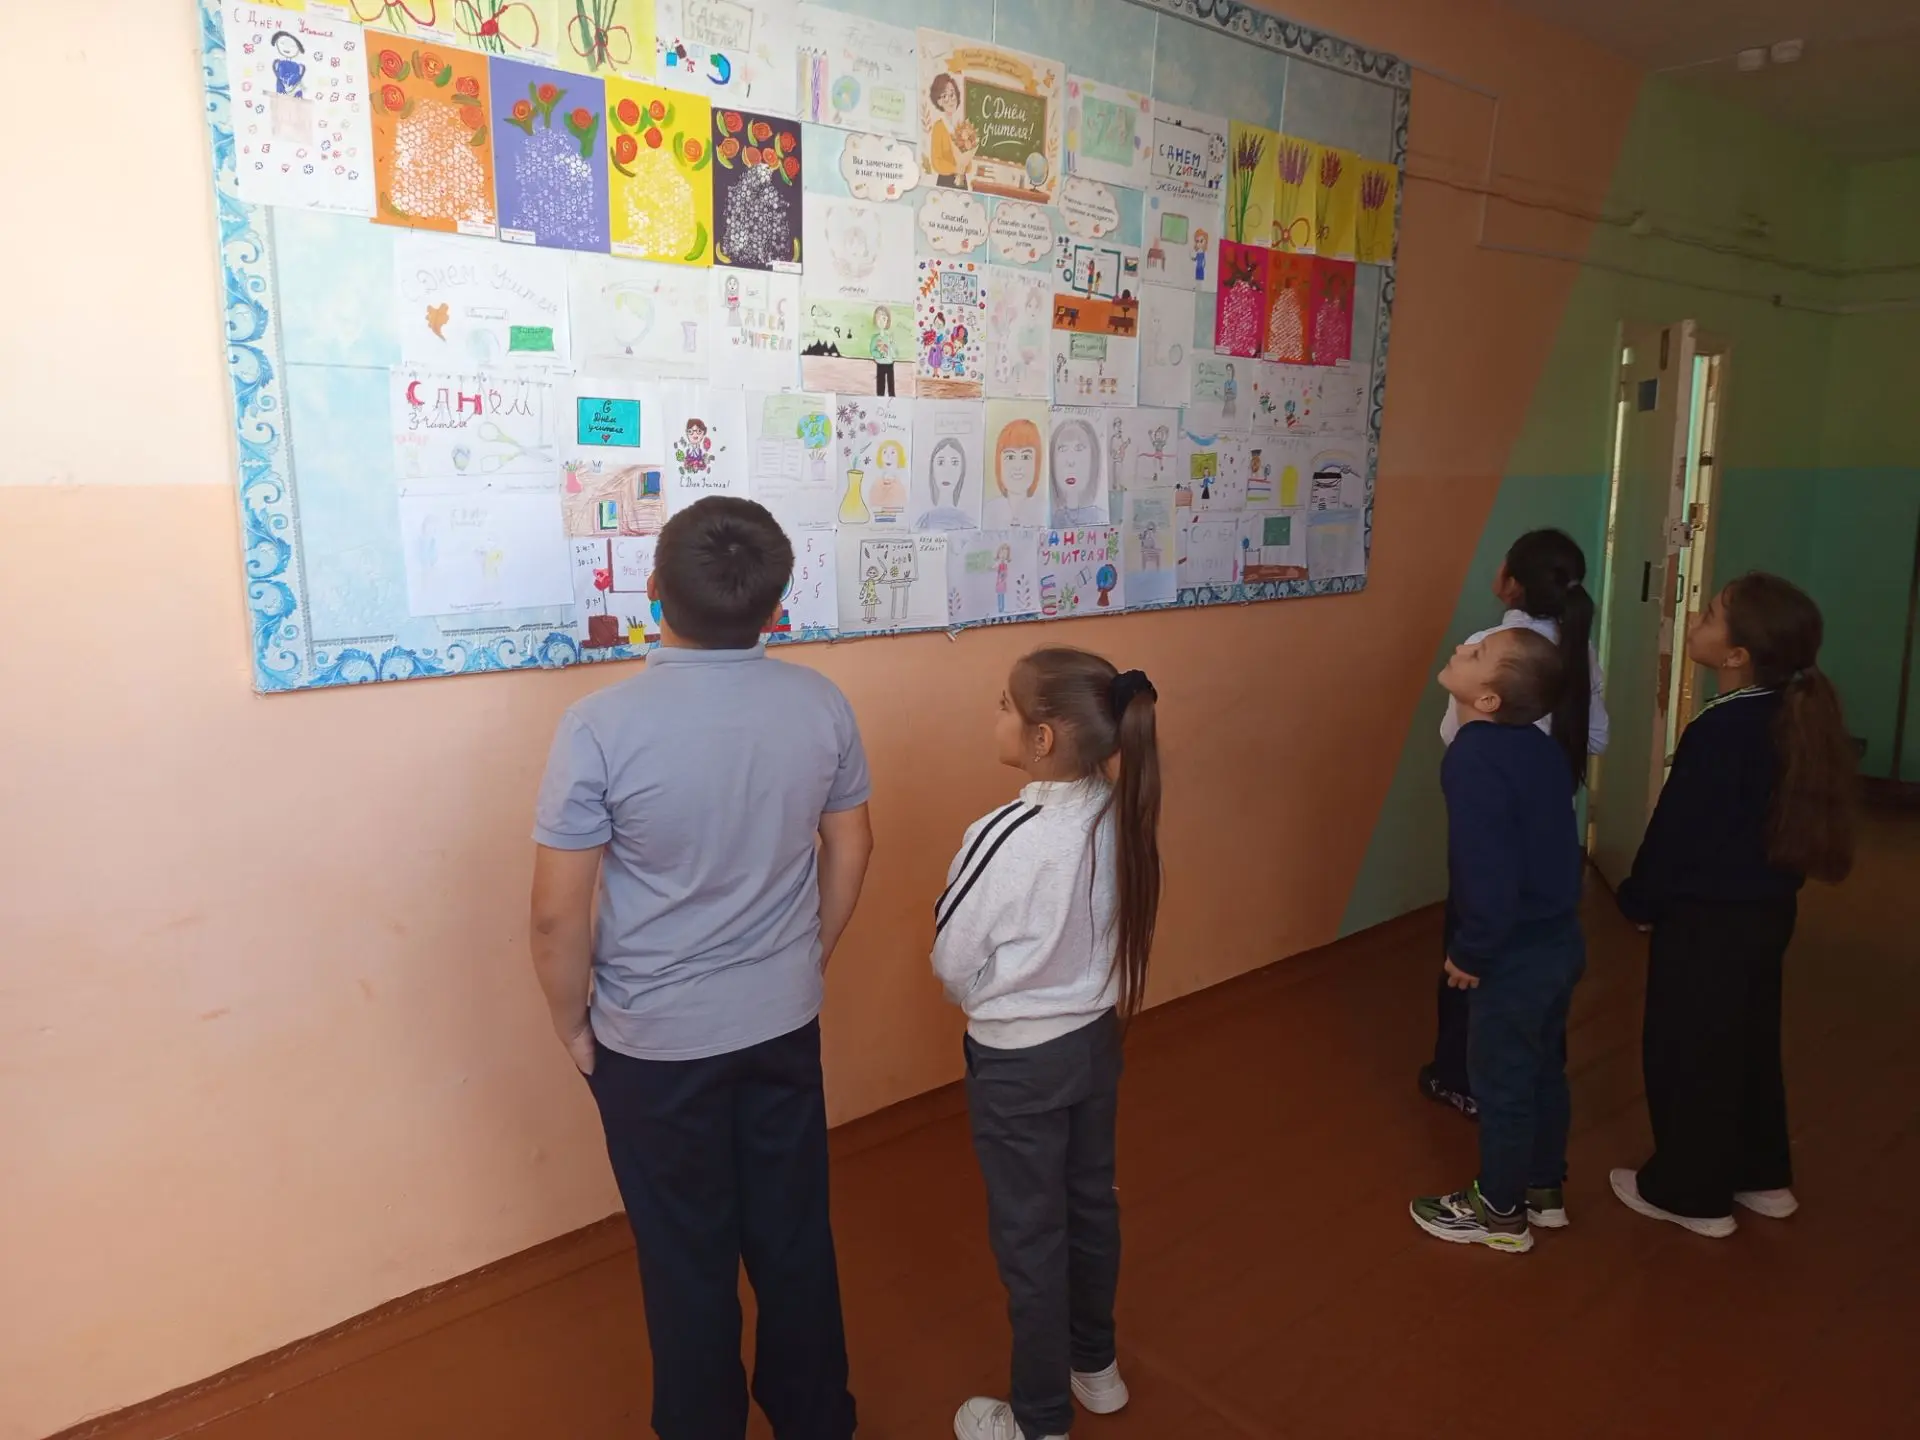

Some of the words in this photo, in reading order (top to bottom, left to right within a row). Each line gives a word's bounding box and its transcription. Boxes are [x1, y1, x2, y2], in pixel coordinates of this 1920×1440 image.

[982, 94, 992, 119] С
[993, 96, 1027, 122] Днём
[981, 122, 1035, 147] учителя!
[852, 155, 864, 165] Вы
[941, 211, 969, 225] Спасибо
[937, 222, 964, 233] каждый
[405, 380, 425, 406] С
[819, 553, 826, 568] 5
[803, 566, 809, 580] 5
